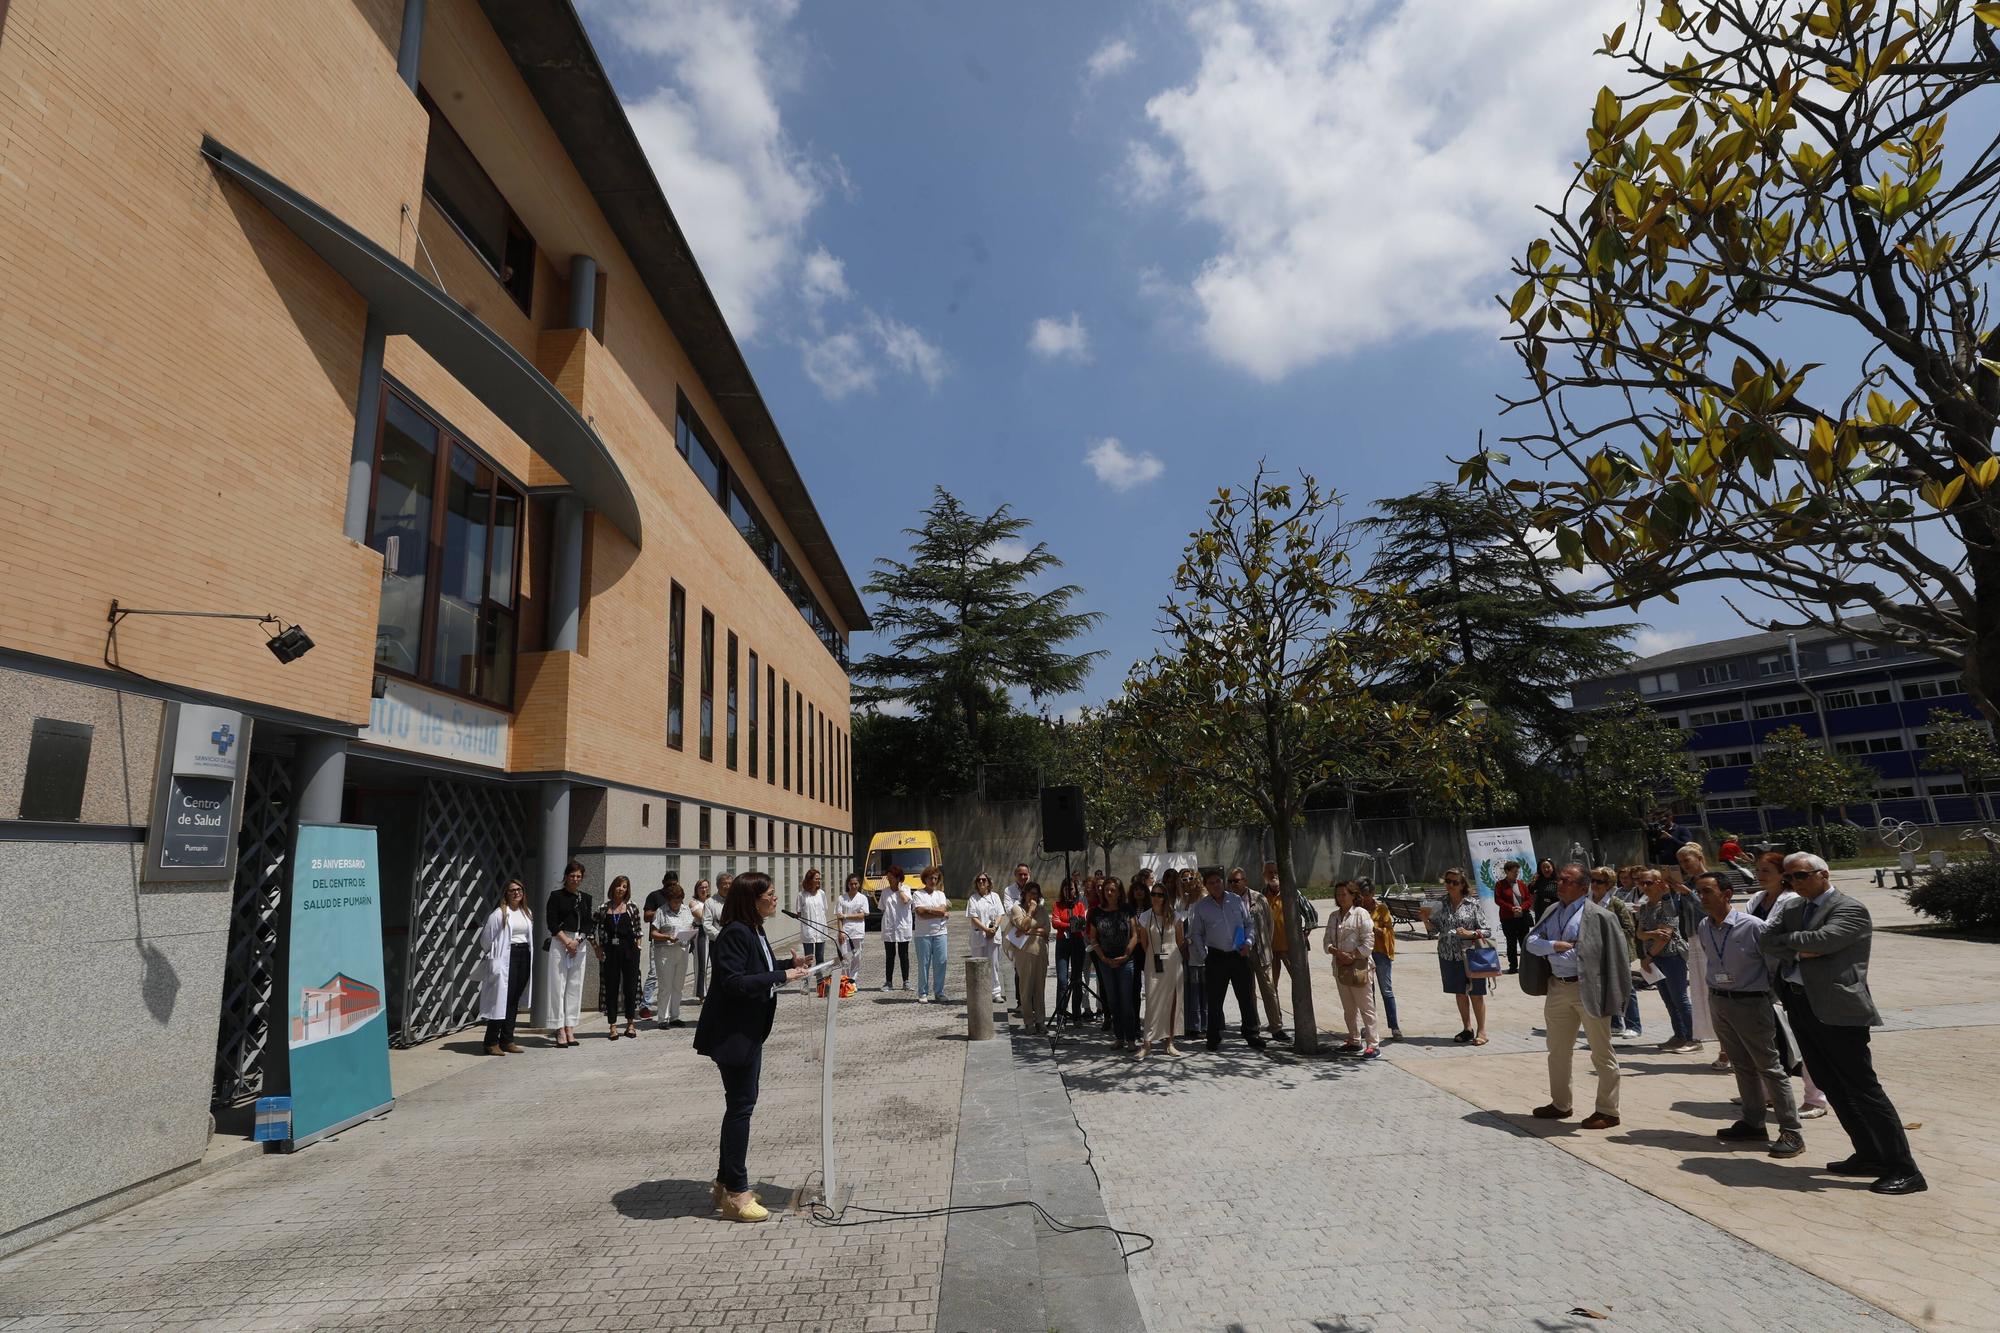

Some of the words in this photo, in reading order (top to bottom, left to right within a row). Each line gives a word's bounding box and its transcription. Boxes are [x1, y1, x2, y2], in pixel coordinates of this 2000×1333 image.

[419, 702, 443, 745] de
[451, 708, 499, 755] Salud
[183, 795, 220, 809] Centro
[178, 813, 191, 825] de
[194, 813, 222, 826] Salud
[311, 859, 322, 869] 25
[323, 859, 366, 869] ANIVERSARIO
[312, 879, 328, 889] DEL
[329, 878, 358, 888] CENTRO
[358, 878, 366, 887] DE
[303, 899, 331, 910] SALUD
[332, 898, 341, 908] DE
